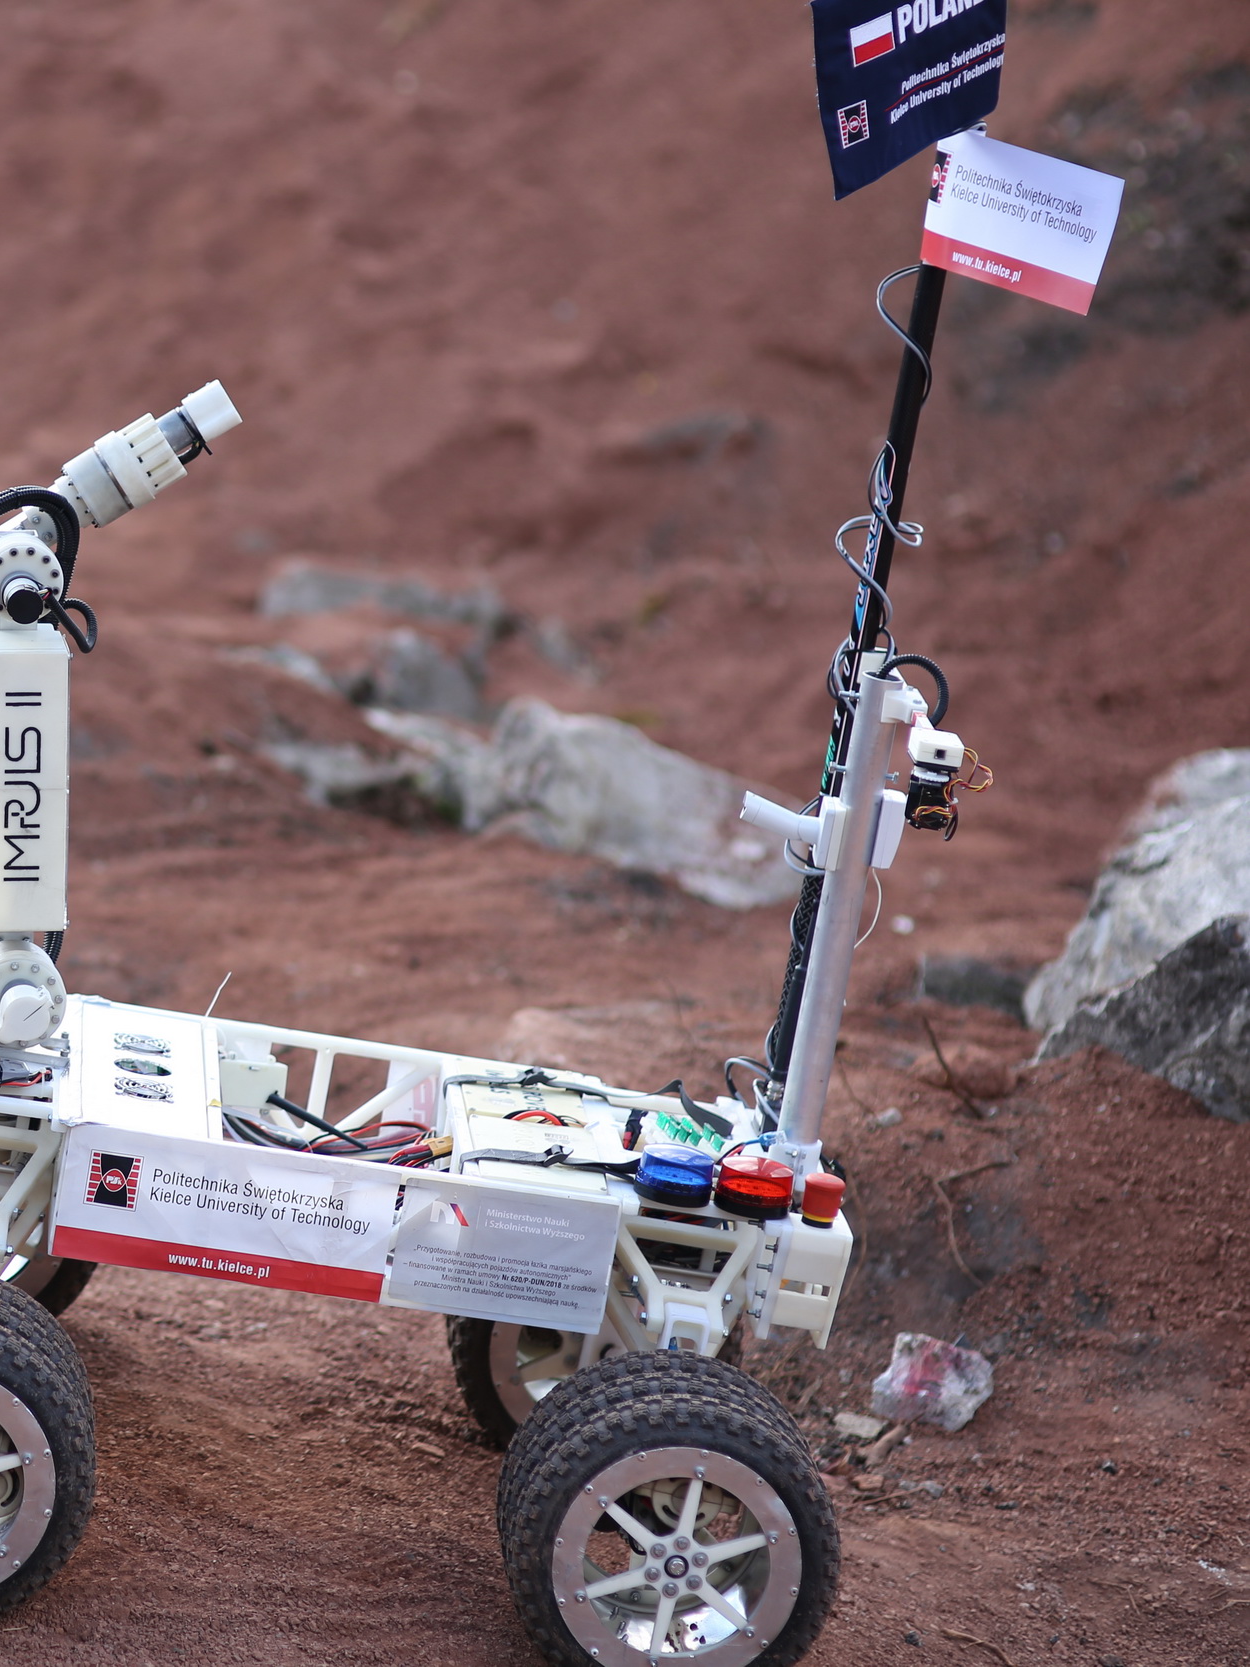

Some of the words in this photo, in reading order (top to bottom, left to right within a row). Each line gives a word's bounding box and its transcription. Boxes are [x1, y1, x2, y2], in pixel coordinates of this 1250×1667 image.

[897, 0, 984, 44] POLA
[890, 102, 909, 124] Kielce
[910, 80, 952, 108] University
[953, 73, 962, 89] of
[963, 52, 1005, 84] Technology
[901, 61, 950, 95] Politechnika
[955, 164, 1013, 195] Politechnika
[1015, 180, 1083, 217] Świętokrzyska
[950, 183, 979, 205] Kielce
[981, 192, 1030, 223] University
[1031, 209, 1043, 223] of
[1044, 211, 1098, 244] Technology
[952, 251, 1022, 283] www.tu.kielce.pl
[3, 727, 41, 881] IMPULS
[152, 1168, 238, 1195] Politechnika
[243, 1180, 344, 1212] Świętokrzyska
[150, 1186, 192, 1205] Kielce
[196, 1193, 267, 1221] University
[271, 1206, 287, 1222] of
[291, 1208, 370, 1236] Technology
[486, 1209, 542, 1224] Ministerstwo
[544, 1217, 570, 1227] Nauki
[489, 1220, 541, 1235] Szkolnictwa
[542, 1228, 585, 1242] Wyższego
[168, 1252, 271, 1279] www.tu.kielce.pl
[408, 1260, 447, 1272] finansowane
[454, 1268, 477, 1277] ramach
[478, 1271, 500, 1281] umowy
[510, 1276, 562, 1288] 620/P-DUN/2018
[570, 1282, 597, 1293] środków
[435, 1256, 489, 1269] współpracujących
[489, 1263, 518, 1274] pojazdów
[463, 1251, 496, 1262] rozbudowa
[501, 1257, 530, 1267] promocja
[531, 1260, 548, 1269] łazika
[549, 1263, 592, 1276] marsjańskiego
[413, 1279, 461, 1292] przeznaczonych
[471, 1287, 504, 1298] działalność
[505, 1293, 559, 1306] upowszechniającą
[441, 1273, 466, 1284] Ministra
[468, 1277, 485, 1286] Nauki
[489, 1281, 524, 1292] Szkolnictwa
[526, 1286, 556, 1297] Wyższego
